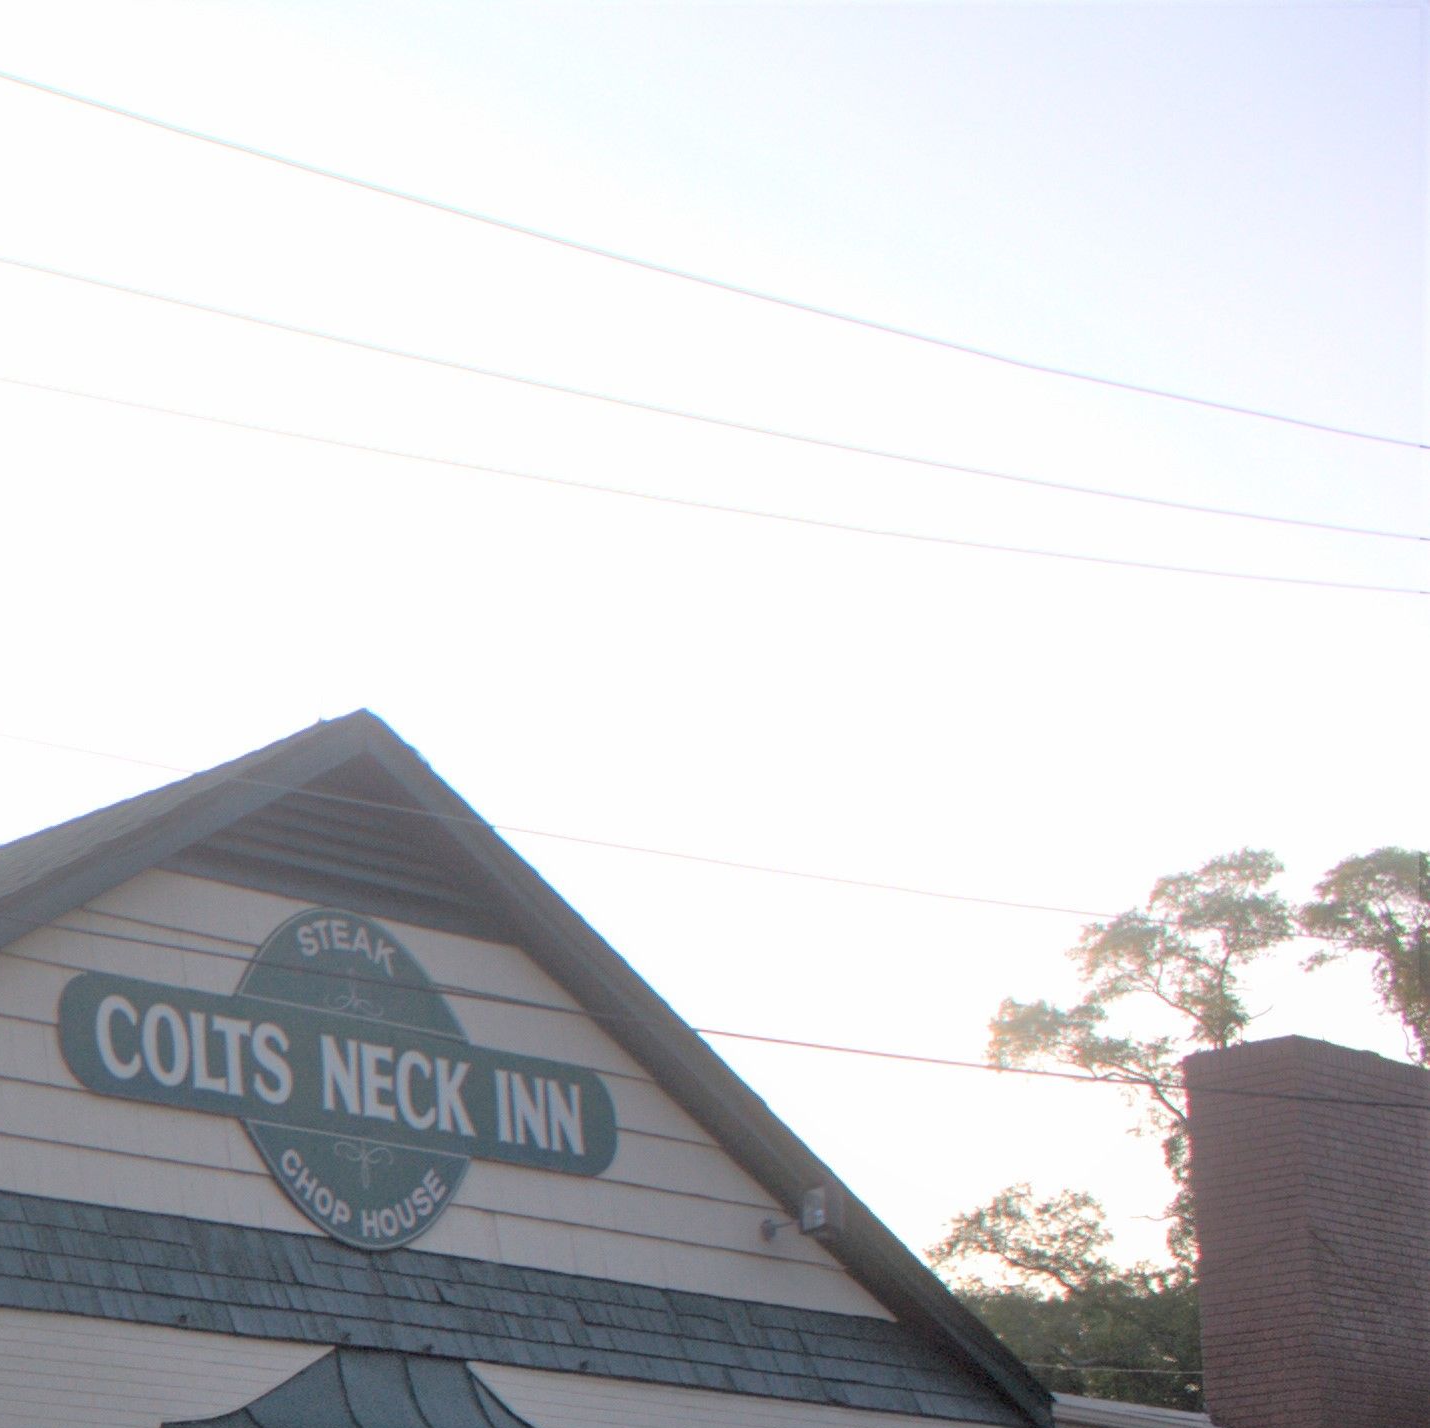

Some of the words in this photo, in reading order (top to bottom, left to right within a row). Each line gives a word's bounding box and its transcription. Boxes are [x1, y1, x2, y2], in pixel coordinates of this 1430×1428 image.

[297, 918, 394, 977] STEAK
[95, 995, 293, 1105] COLTS
[320, 1034, 476, 1137] NECK
[494, 1069, 585, 1156] INN
[280, 1148, 352, 1227] CHOP
[360, 1168, 447, 1239] HOUSE
